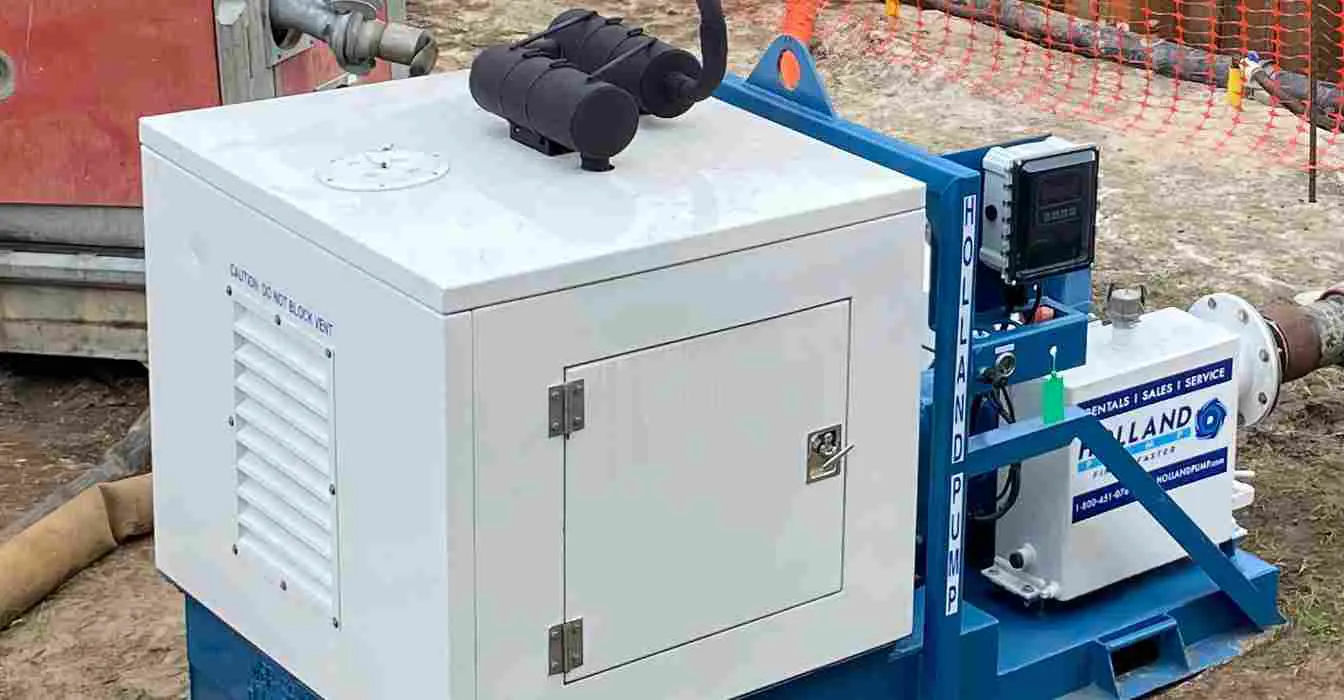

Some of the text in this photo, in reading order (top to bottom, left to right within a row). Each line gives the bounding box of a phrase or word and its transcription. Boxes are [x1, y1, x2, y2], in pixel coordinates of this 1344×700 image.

[261, 282, 272, 299] DO
[273, 291, 288, 309] NOT
[289, 300, 313, 324] BLOCK
[313, 314, 334, 336] VENT
[948, 198, 975, 612] HOLLAND PUMP
[1142, 383, 1173, 401] SALES
[1185, 367, 1225, 388] SERVICE
